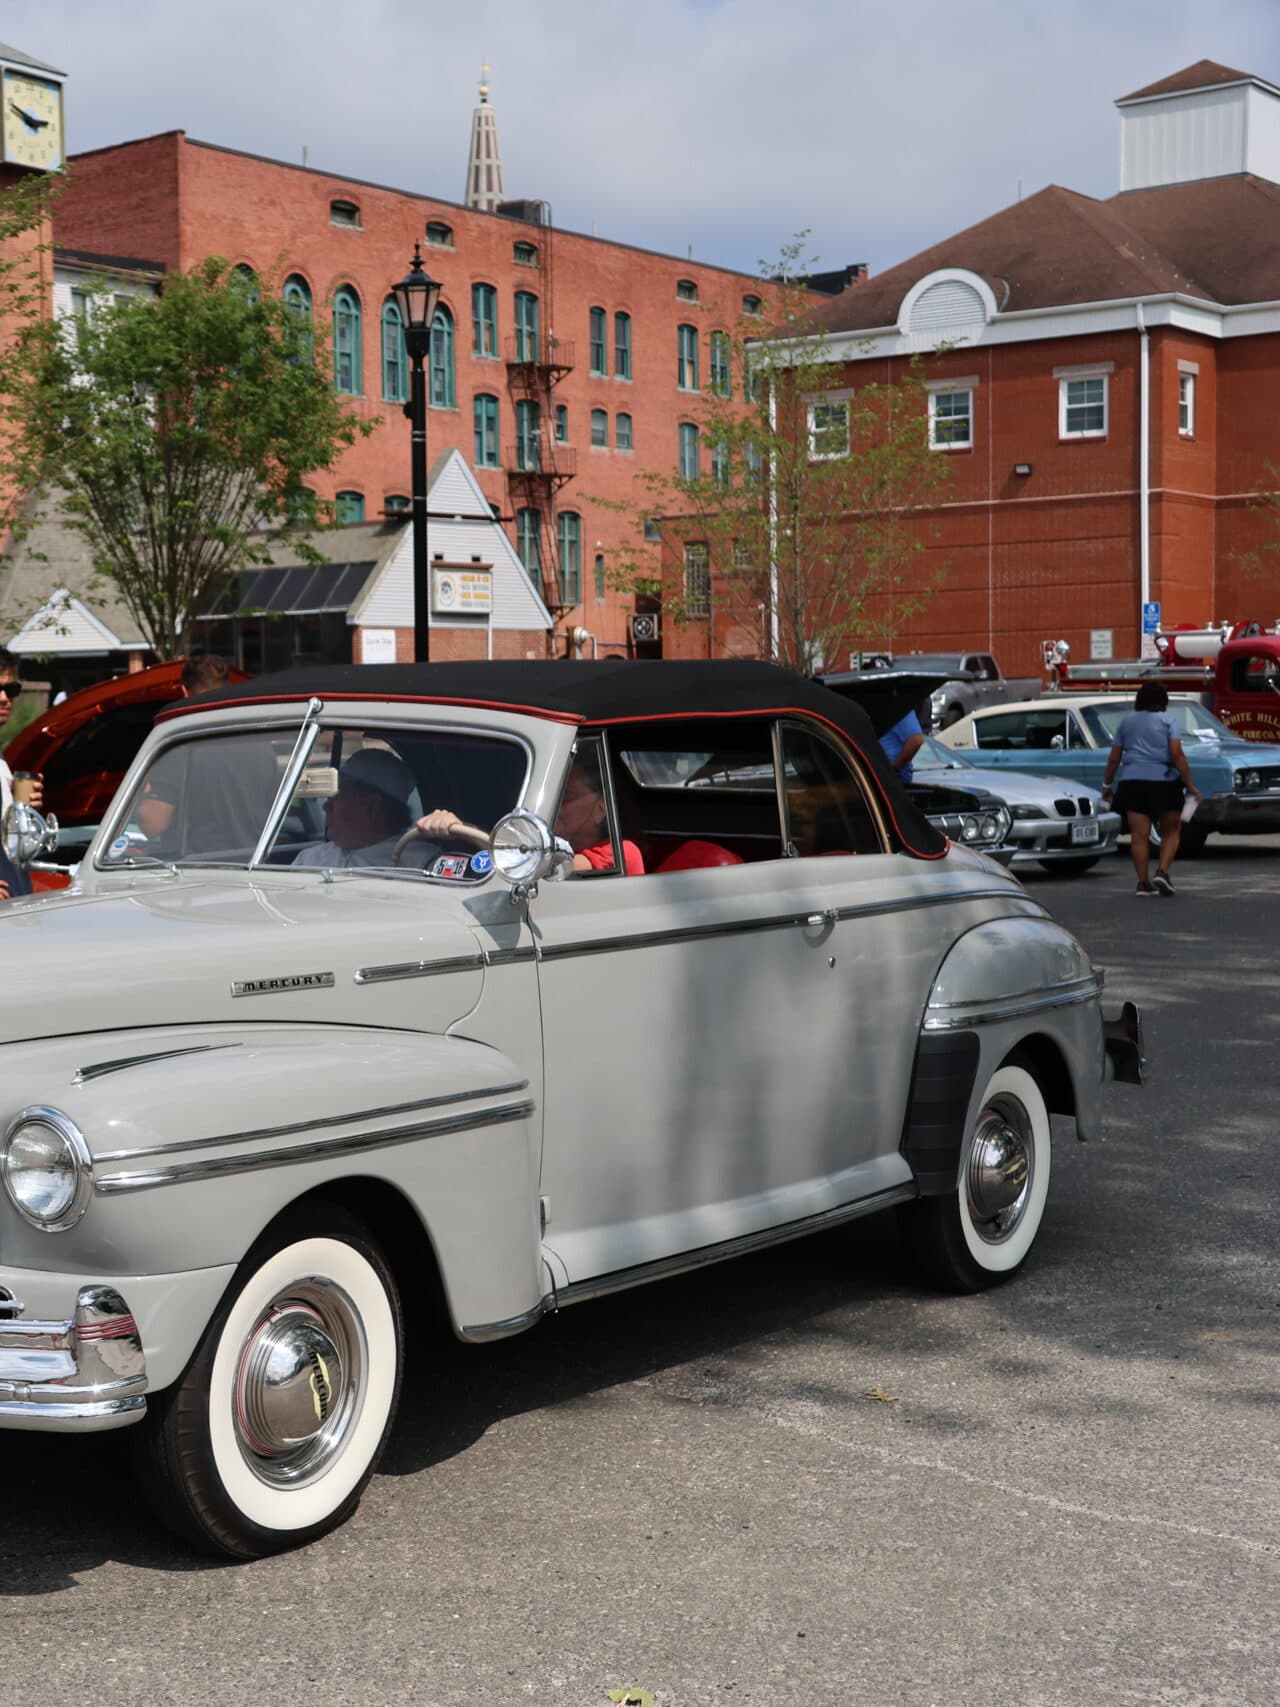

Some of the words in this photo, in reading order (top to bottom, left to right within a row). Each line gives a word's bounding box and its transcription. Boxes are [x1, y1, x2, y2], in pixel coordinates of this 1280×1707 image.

[1257, 712, 1280, 728] HILL
[242, 975, 325, 993] MERCURY
[308, 1351, 328, 1419] MERCURY
